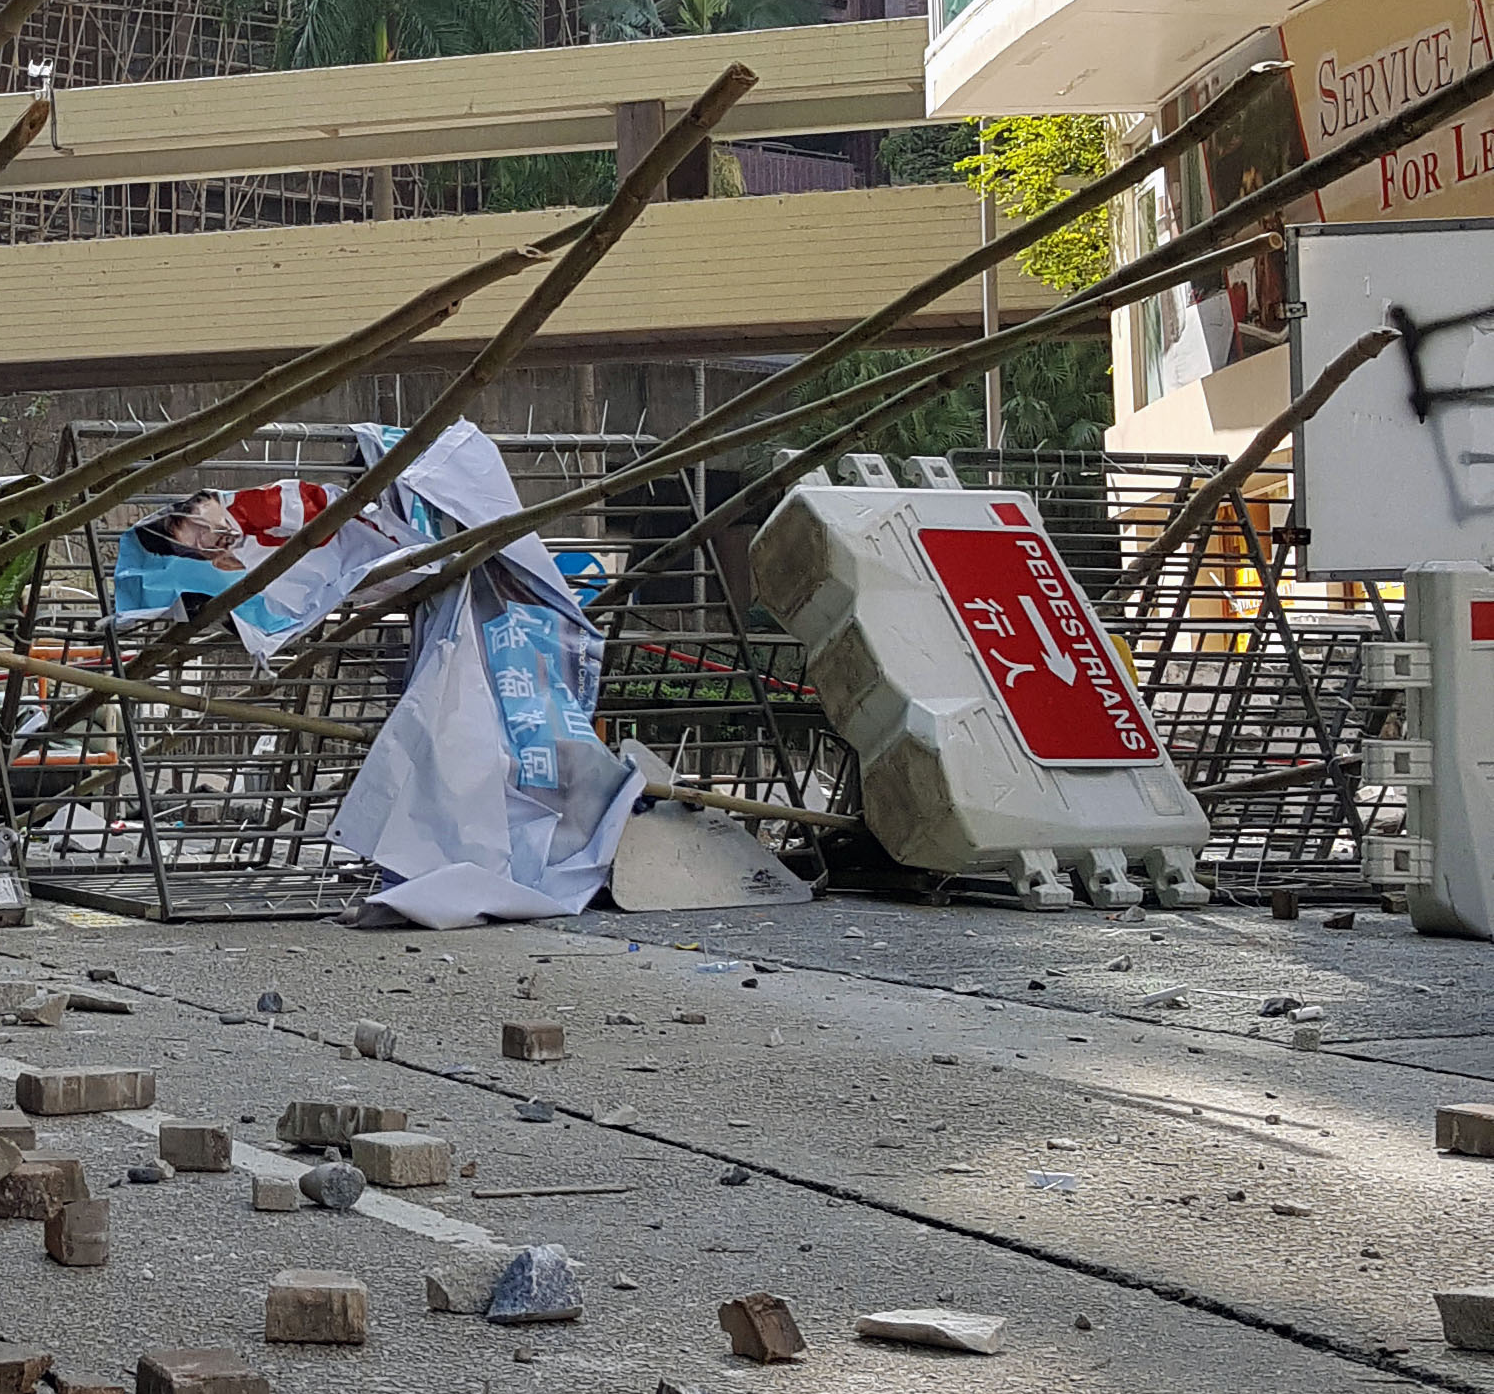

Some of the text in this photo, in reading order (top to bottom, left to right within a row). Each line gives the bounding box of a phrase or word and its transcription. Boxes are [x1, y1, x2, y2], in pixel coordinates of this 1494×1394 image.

[1318, 28, 1454, 141] SERVICE
[1380, 151, 1442, 211] FOR
[964, 597, 1036, 688] 行人
[1015, 540, 1146, 752] PEDESTRIANS
